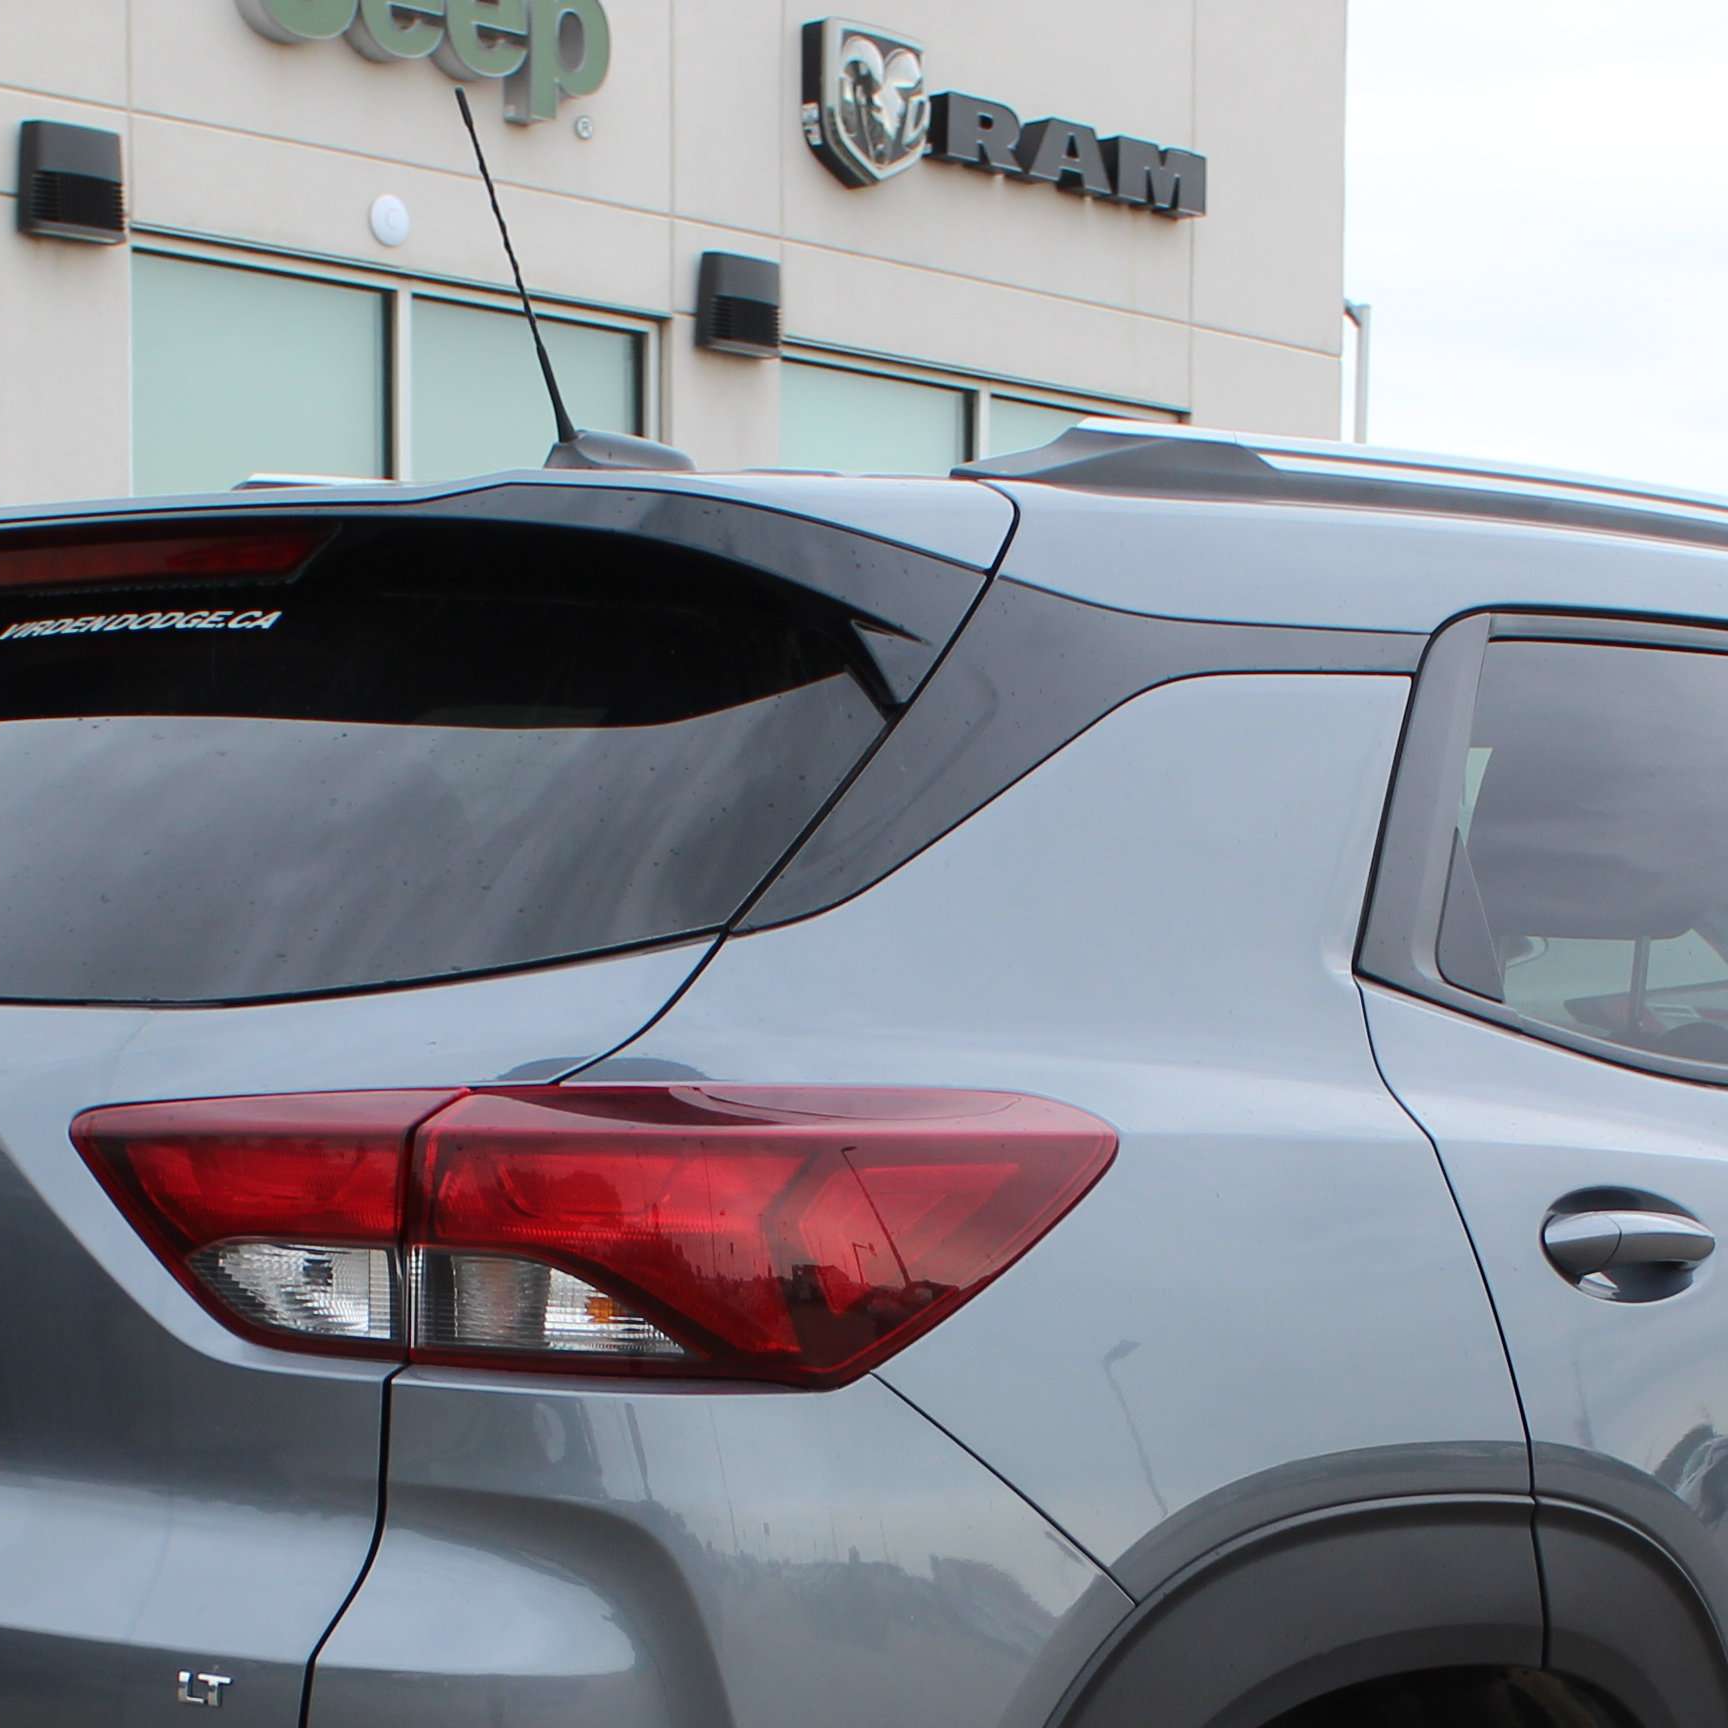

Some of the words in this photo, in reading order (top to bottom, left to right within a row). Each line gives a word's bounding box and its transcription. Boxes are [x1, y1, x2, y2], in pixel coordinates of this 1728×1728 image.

[236, 0, 611, 124] eep
[928, 90, 1206, 219] RAM
[177, 1670, 232, 1707] LT
